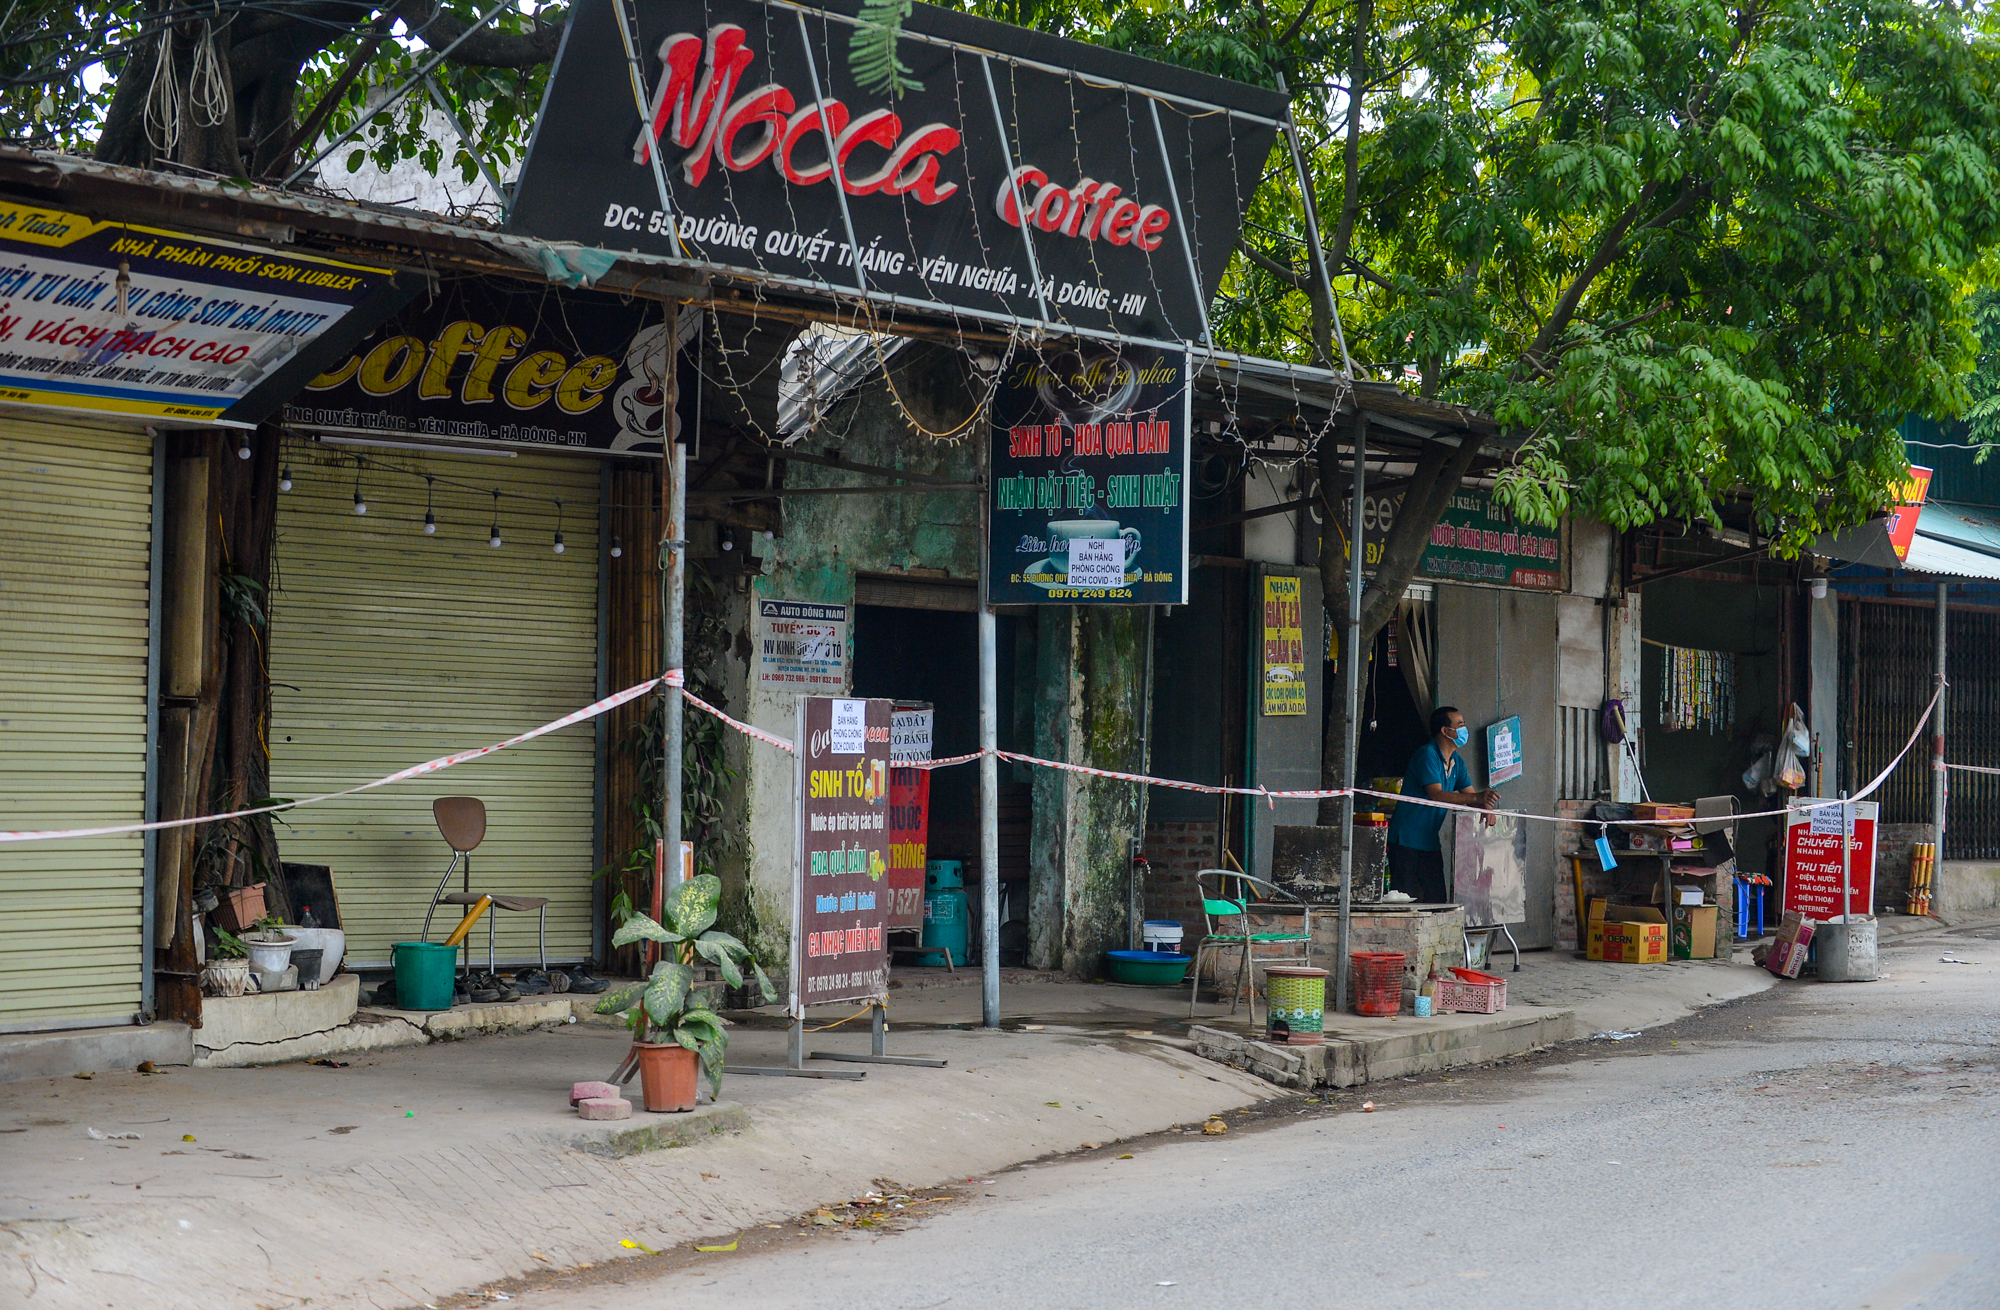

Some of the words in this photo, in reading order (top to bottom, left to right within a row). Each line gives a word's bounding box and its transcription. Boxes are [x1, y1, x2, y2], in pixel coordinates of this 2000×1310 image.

[995, 164, 1171, 252] Coffee
[18, 214, 72, 238] Tuấn
[109, 237, 159, 259] NHÀ
[154, 247, 214, 269] PHÂN
[209, 255, 264, 276] PHỐI
[257, 263, 303, 281] SƠN
[296, 270, 364, 291] LUBLEX
[604, 203, 645, 231] ĐC:
[679, 213, 758, 250] ĐƯỜNG
[764, 228, 835, 263] QUYẾT
[836, 235, 905, 275] THẮNG
[920, 255, 959, 285] YÊN
[958, 266, 1018, 295] NGHĨA
[1058, 279, 1110, 311] ĐÔNG
[1118, 293, 1148, 317] HN
[135, 288, 200, 321] CÔNG
[189, 299, 245, 328] SƠN
[255, 308, 330, 338] MATIT
[25, 317, 110, 349] VÁCH
[101, 330, 197, 359] THẠCH
[189, 341, 251, 365] CAO
[1137, 355, 1178, 388] nhạc
[315, 408, 360, 427] QUYẾT
[361, 411, 407, 432] THẮNG
[418, 415, 446, 435] YÊN
[448, 420, 490, 439] NGHĨA
[500, 422, 519, 441] HÀ
[521, 425, 557, 444] ĐÔNG
[567, 431, 588, 447] HN
[1009, 425, 1042, 458] SINH
[1044, 412, 1063, 457] TỐ
[1074, 422, 1103, 457] HOA
[1105, 408, 1134, 459] QUẢ
[998, 470, 1035, 517] NHẬN
[1037, 470, 1064, 517] ĐẶT
[1065, 470, 1096, 516] TIỆC
[1107, 474, 1141, 508] SINH
[1143, 467, 1181, 515] NHẬT
[1430, 519, 1456, 548] NƯỚC
[1457, 521, 1481, 550] UỐNG
[1482, 529, 1500, 553] HOA
[1502, 526, 1519, 556] QUẢ
[1520, 532, 1538, 557] CÁC
[1538, 536, 1558, 563] LOẠI
[1022, 573, 1031, 582] 55
[1032, 570, 1053, 583] ĐƯỜNG
[1143, 571, 1153, 582] HÀ
[1088, 576, 1109, 585] COVID
[1114, 576, 1122, 585] 19
[1269, 578, 1296, 597] NHẬN
[1048, 588, 1079, 598] 0978
[1082, 588, 1106, 598] 249
[1108, 588, 1133, 598] 824
[780, 606, 800, 617] AUTO
[802, 605, 824, 618] ĐÔNG
[825, 609, 844, 619] NAM
[1289, 595, 1302, 629] LÀ
[763, 639, 775, 655] NV
[776, 640, 795, 656] KINH
[1291, 639, 1304, 664] GA
[843, 741, 856, 751] COVID
[904, 731, 929, 745] BÁNH
[810, 769, 843, 799] SINH
[846, 757, 866, 798] TỐ
[811, 850, 828, 876] HOA
[829, 840, 846, 878] QUẢ
[1796, 848, 1825, 856] NHANH
[1796, 861, 1818, 872] THU
[1799, 883, 1812, 892] TRẢ
[1814, 895, 1834, 904] THOẠI
[816, 892, 838, 914] Nước
[896, 887, 921, 916] 527
[808, 931, 820, 958] CA
[821, 929, 844, 960] NHẠC
[867, 921, 882, 951] PHÍ
[1594, 933, 1633, 944] MODERN
